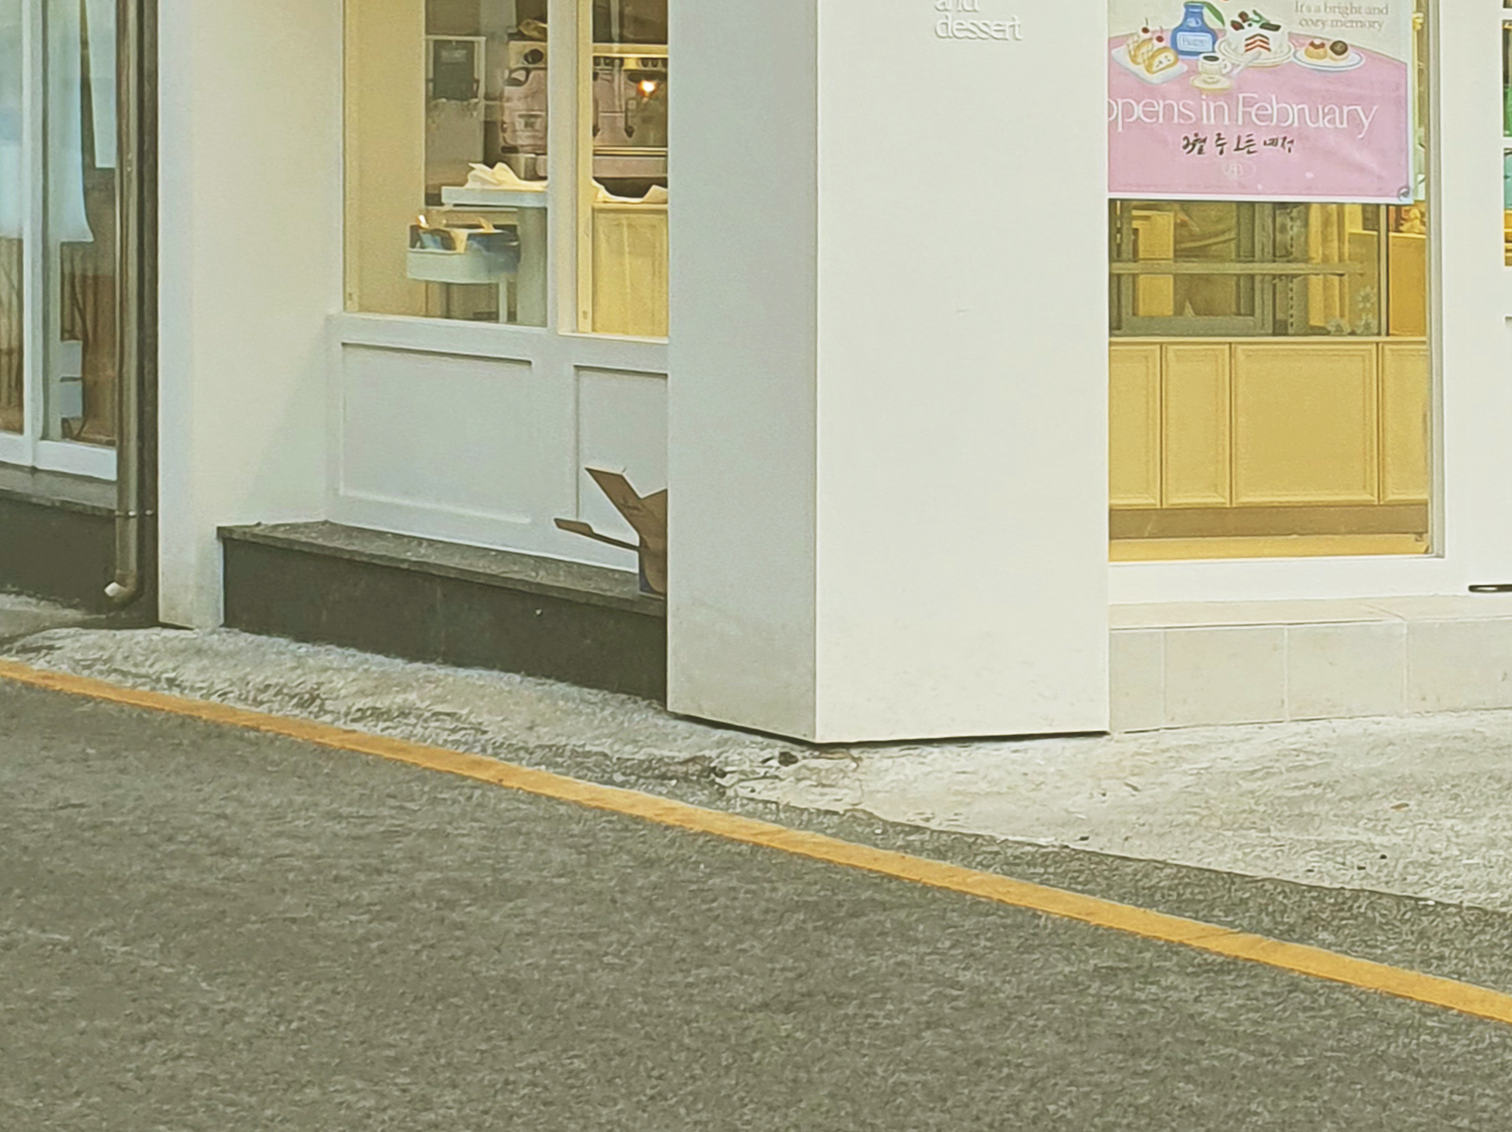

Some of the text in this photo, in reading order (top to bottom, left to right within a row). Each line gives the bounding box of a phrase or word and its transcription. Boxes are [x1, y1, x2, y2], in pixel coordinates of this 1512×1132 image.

[1324, 2, 1362, 18] bright
[1365, 3, 1389, 15] and
[934, 15, 1023, 40] dessert
[1201, 94, 1229, 126] in
[1238, 93, 1378, 139] February
